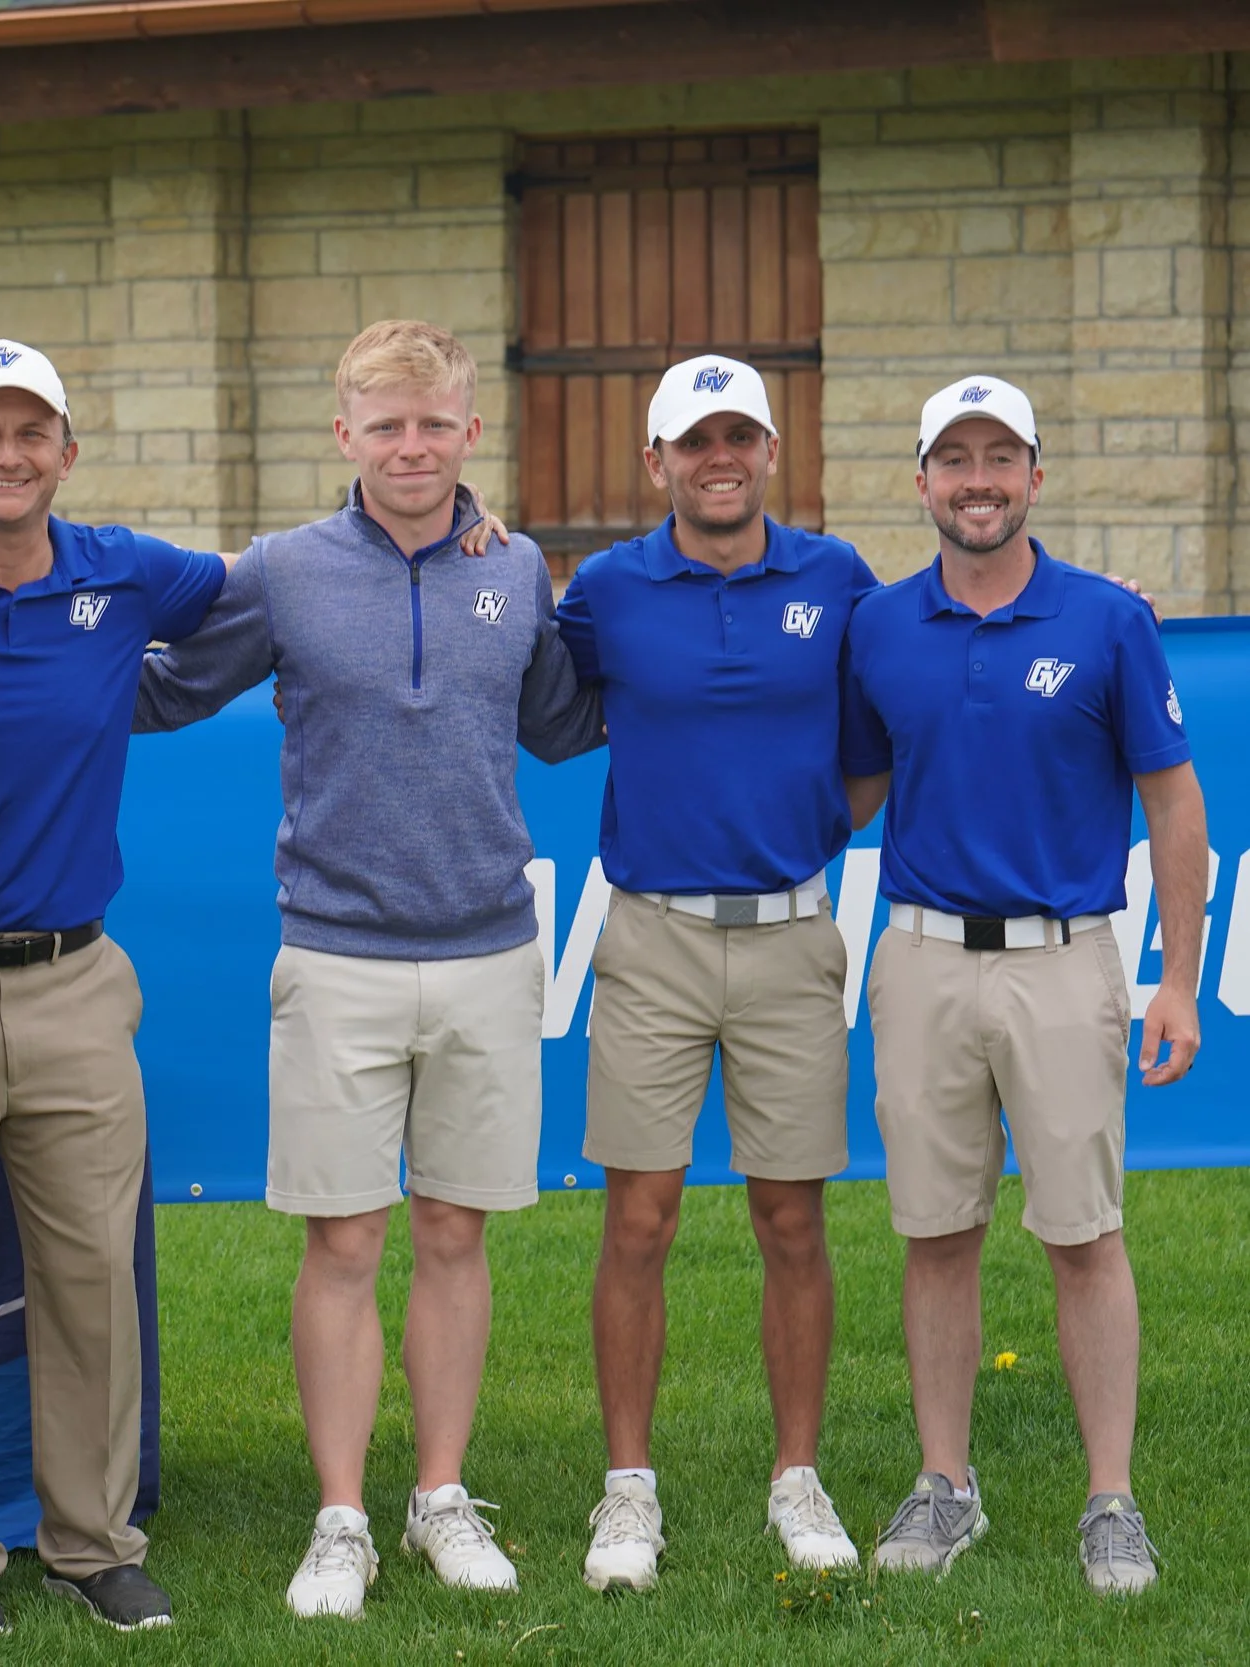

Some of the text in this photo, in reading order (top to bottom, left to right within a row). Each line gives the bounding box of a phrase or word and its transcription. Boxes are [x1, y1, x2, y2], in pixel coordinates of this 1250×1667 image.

[693, 366, 734, 393] GV
[69, 592, 111, 630] GV
[472, 588, 509, 624] GV
[782, 602, 823, 638] GV
[1024, 657, 1076, 698] GV
